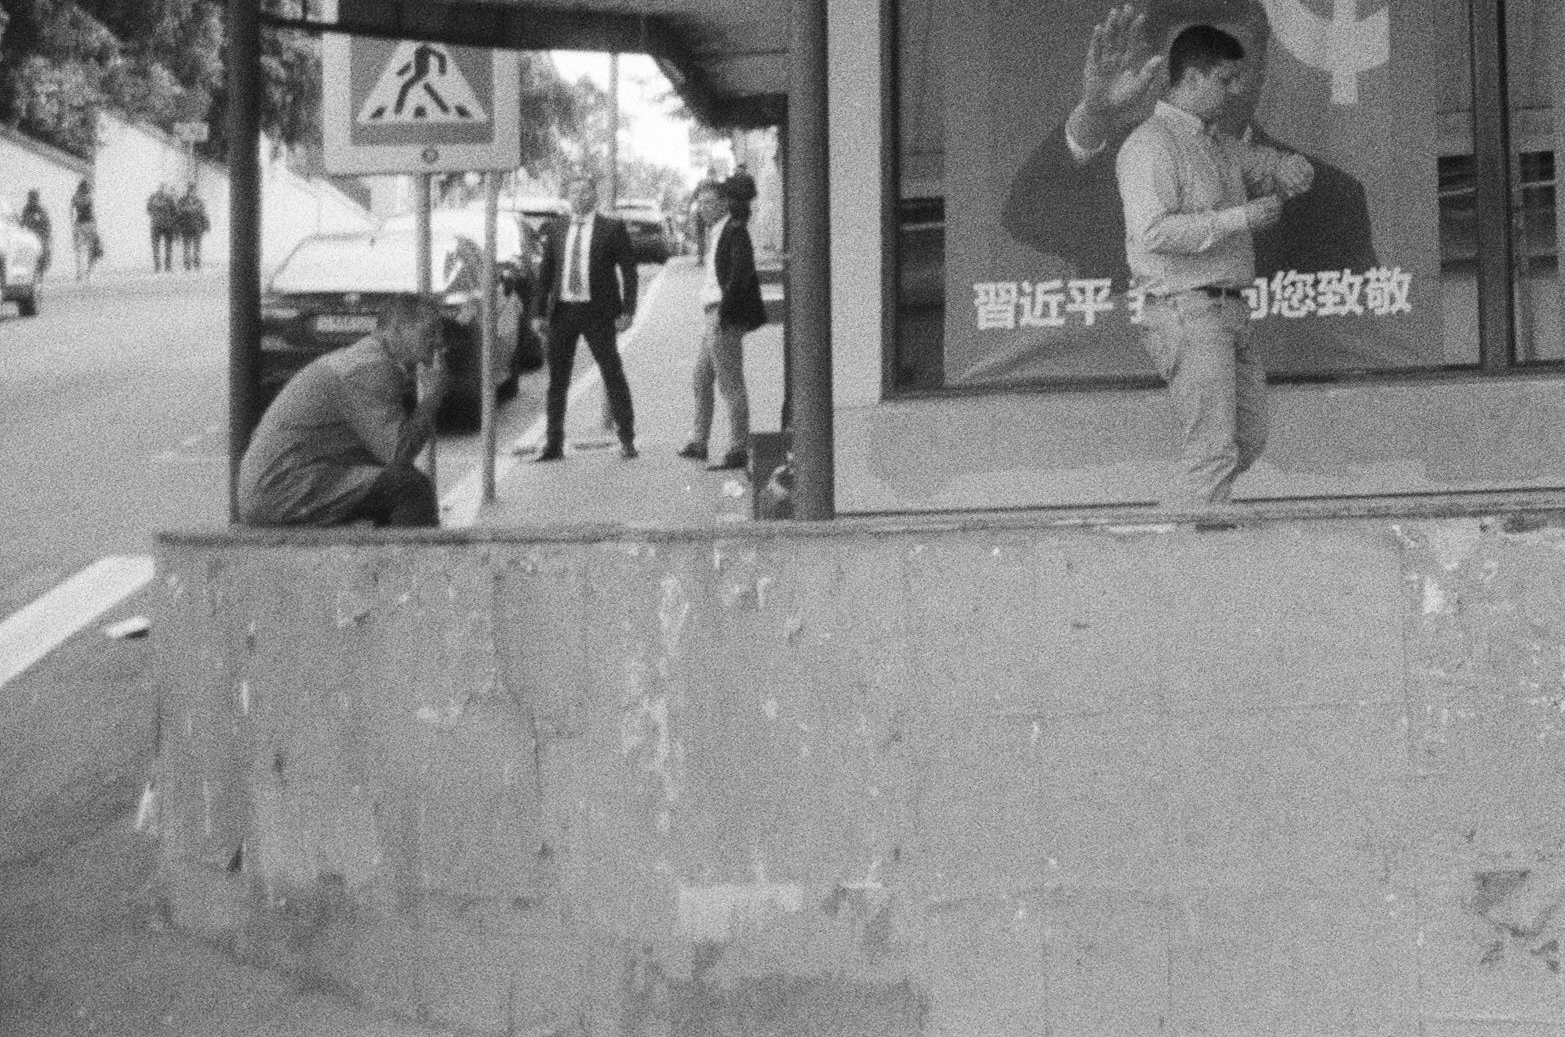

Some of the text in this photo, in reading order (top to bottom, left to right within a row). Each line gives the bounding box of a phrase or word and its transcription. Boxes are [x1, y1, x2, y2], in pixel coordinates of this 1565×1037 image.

[973, 267, 1413, 330] 習近平 您致敬
